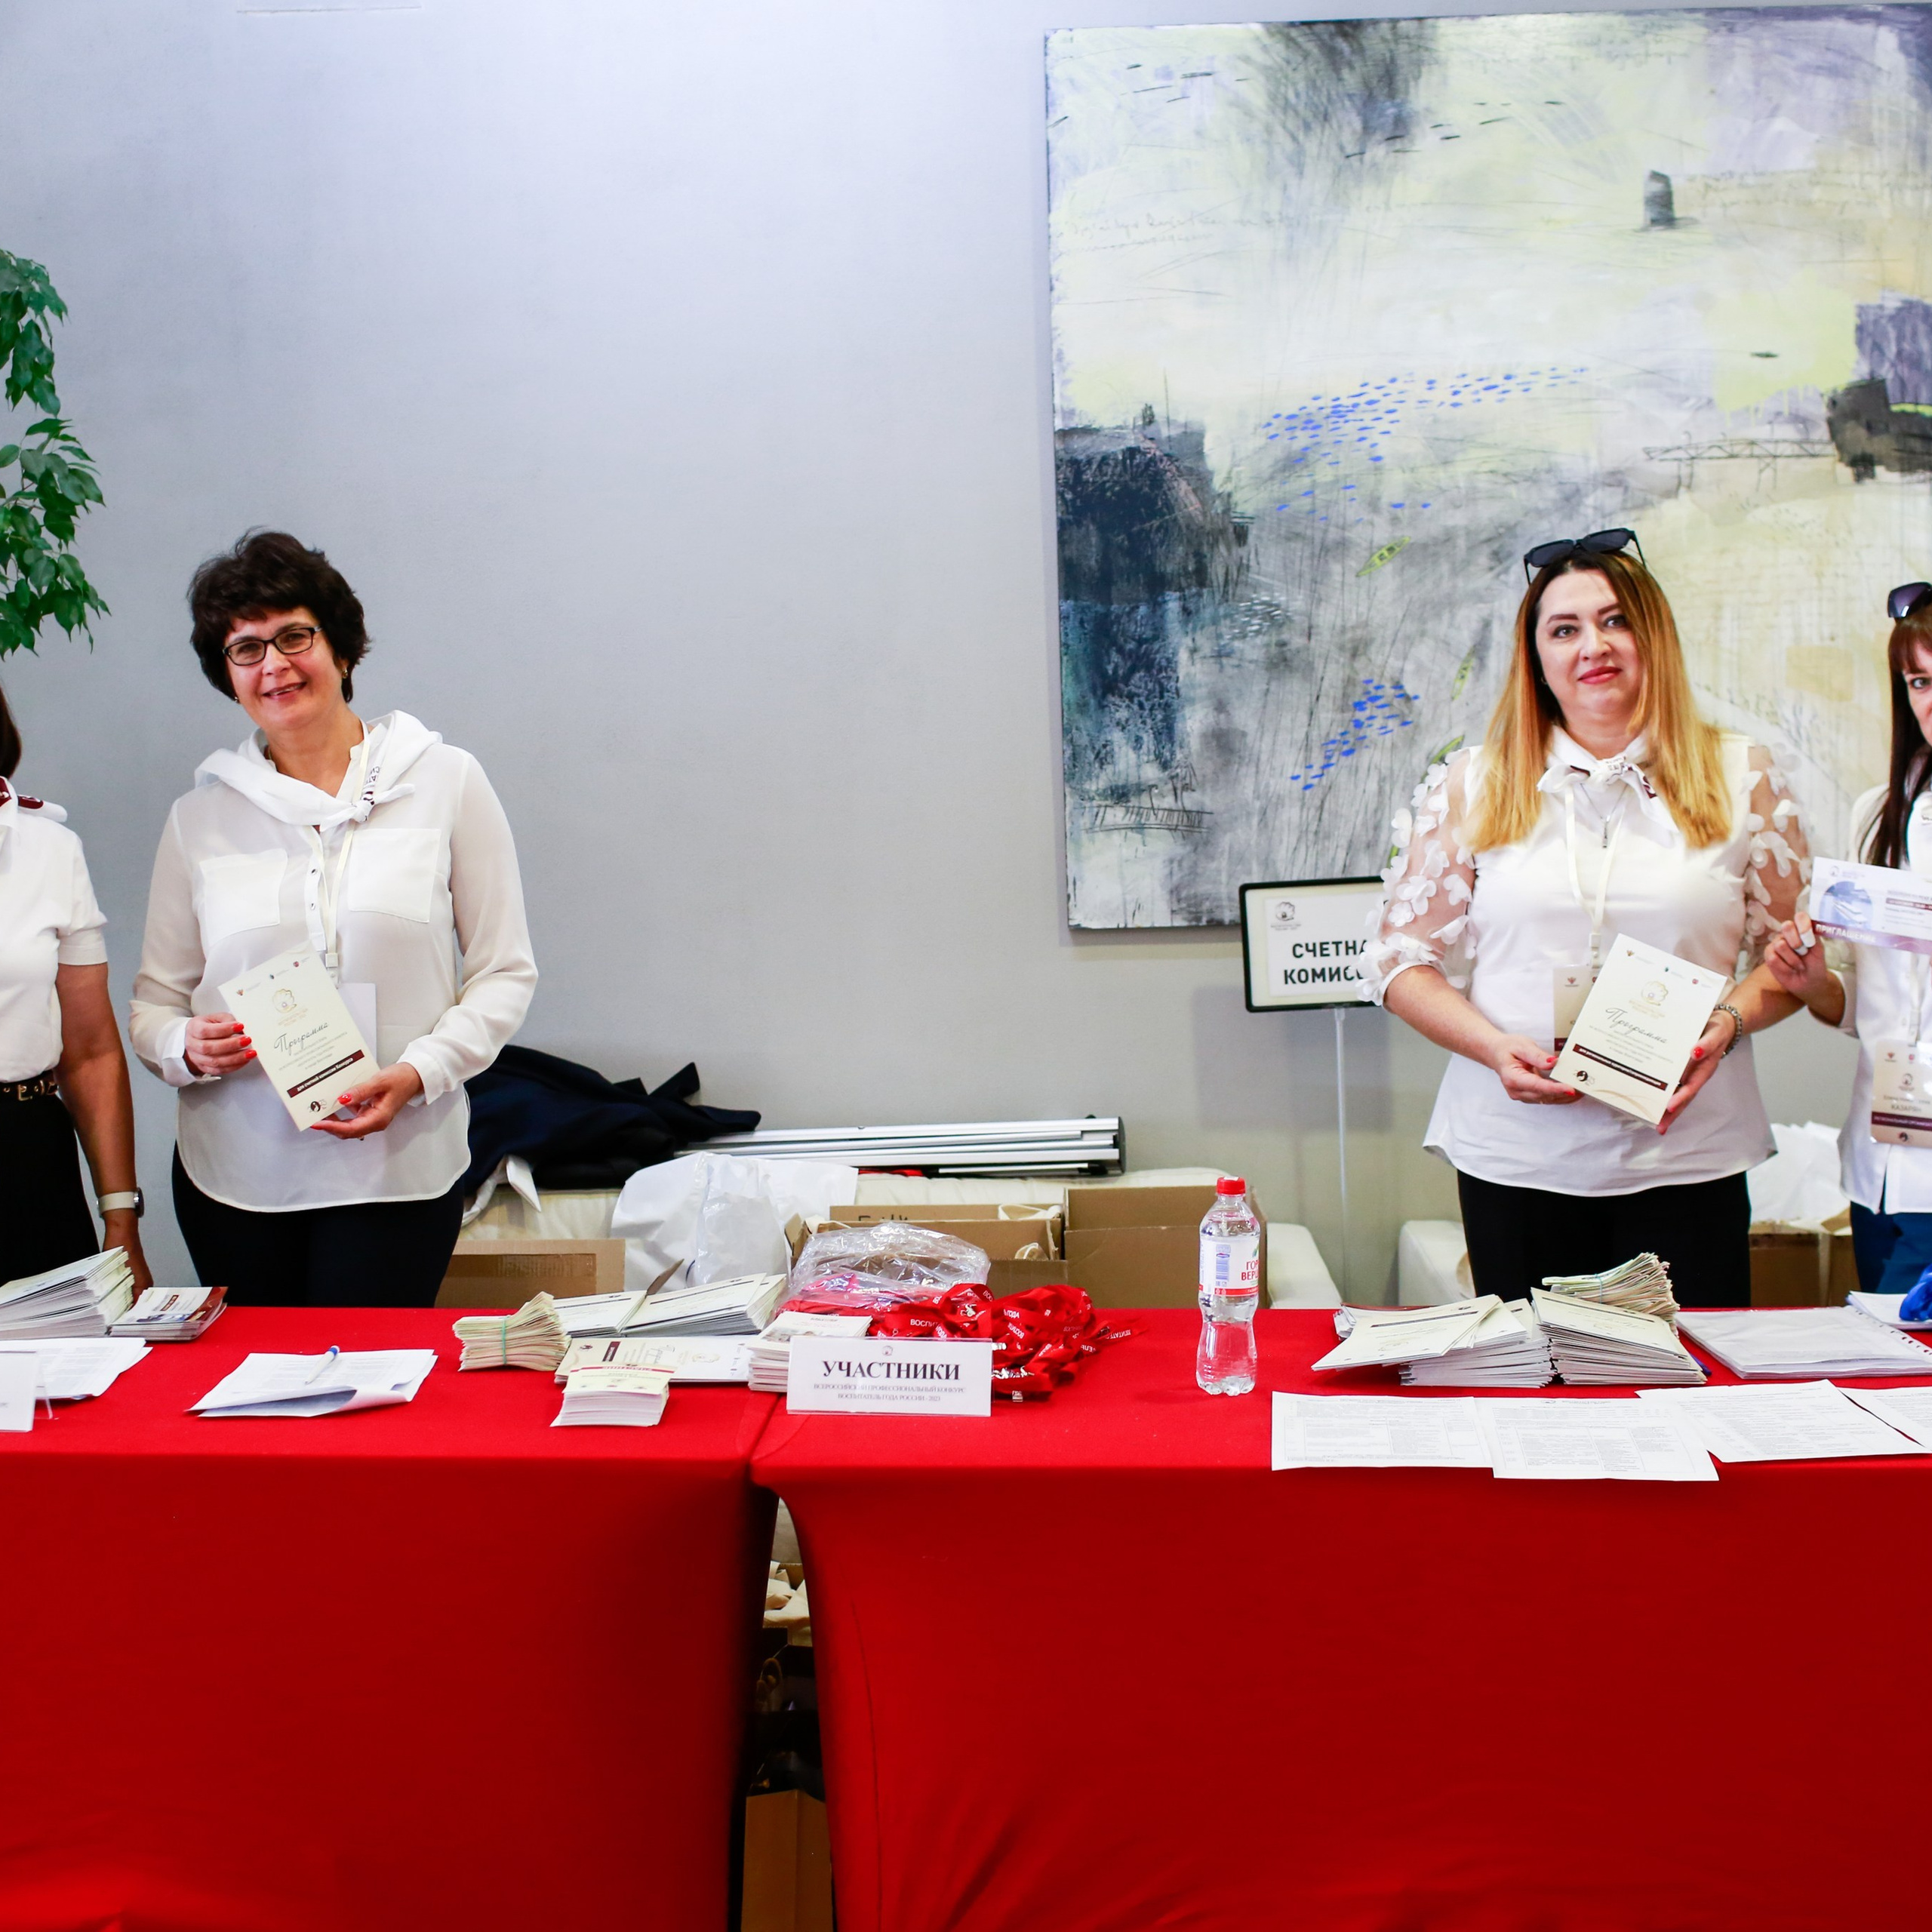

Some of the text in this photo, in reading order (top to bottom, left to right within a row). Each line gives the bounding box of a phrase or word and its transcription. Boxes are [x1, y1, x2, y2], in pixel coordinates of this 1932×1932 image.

[1605, 1008, 1667, 1043] Программа
[273, 1022, 328, 1056] Программа
[822, 1361, 961, 1380] УЧАСТНИКИ
[868, 1384, 936, 1392] ПРОФЕССИОНАЛЬНЫЙ
